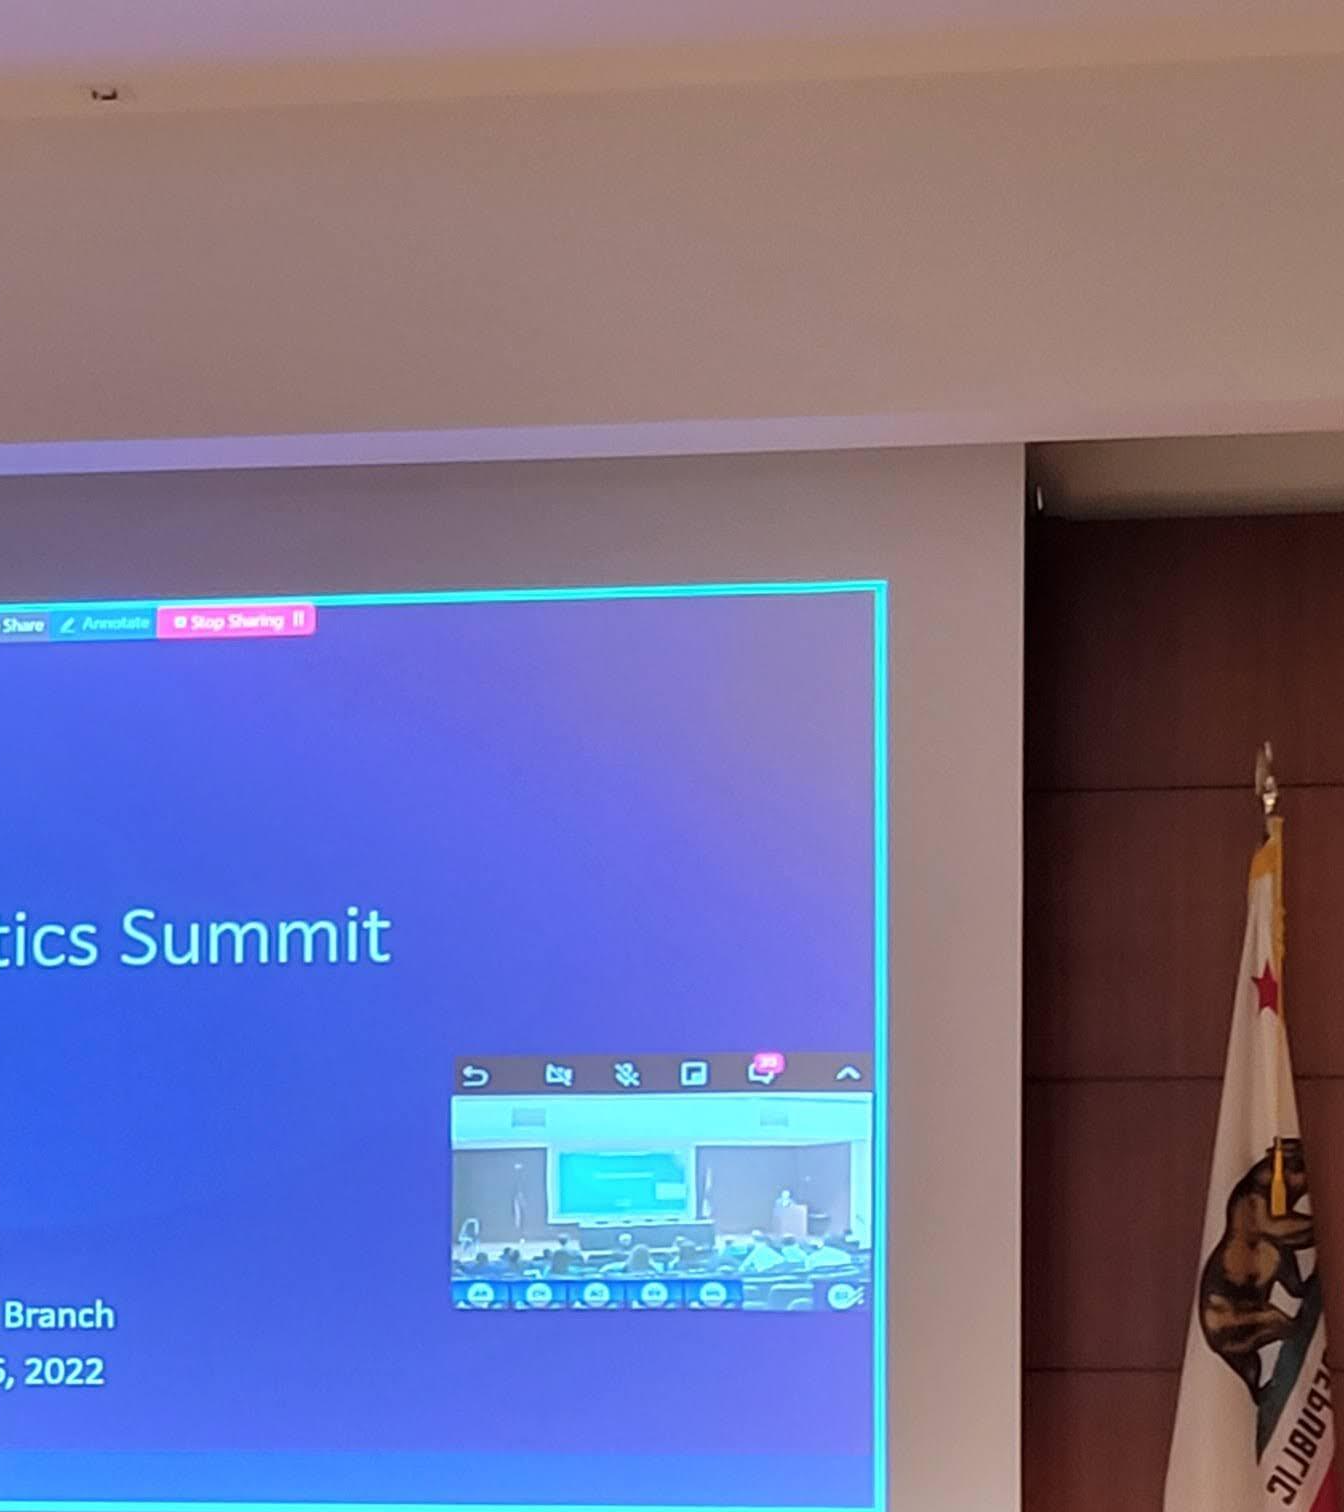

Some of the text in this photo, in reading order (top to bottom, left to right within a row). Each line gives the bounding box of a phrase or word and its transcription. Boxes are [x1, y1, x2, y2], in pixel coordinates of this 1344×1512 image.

[3, 617, 44, 633] Share
[82, 616, 151, 631] Annotate
[191, 613, 284, 632] Stop Sharing
[120, 905, 392, 966] Summit
[4, 1298, 115, 1329] Branch
[23, 1356, 105, 1386] 2022
